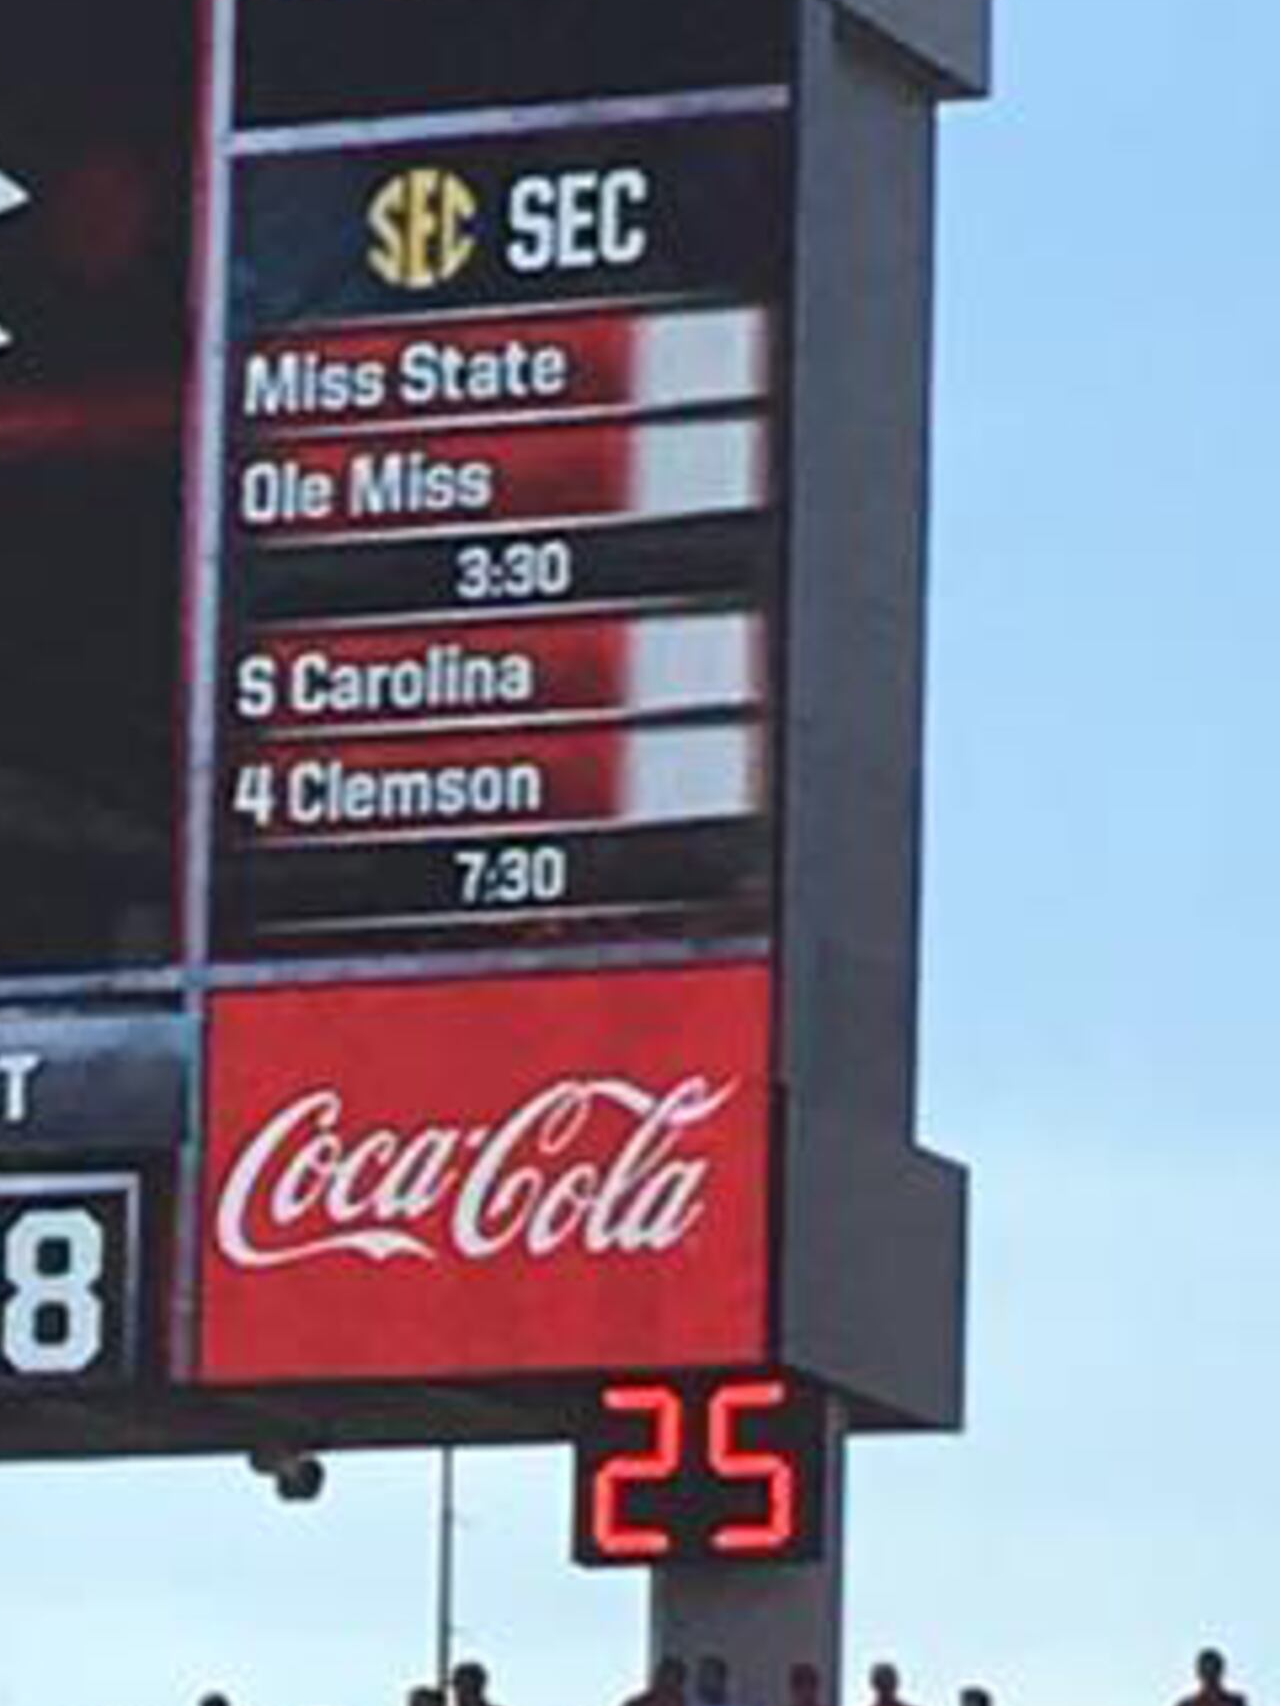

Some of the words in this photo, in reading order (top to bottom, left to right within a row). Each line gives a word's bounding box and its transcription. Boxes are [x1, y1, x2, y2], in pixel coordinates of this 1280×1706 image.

[505, 167, 647, 272] SEC
[243, 355, 386, 415] Miss
[399, 341, 568, 401] State
[241, 462, 333, 523] Ole
[349, 451, 493, 515] Miss
[456, 541, 571, 599] 3:30
[237, 656, 276, 718] S
[289, 645, 533, 710] Carolina
[233, 766, 273, 826] 4
[287, 761, 541, 822] Clemson
[454, 846, 566, 903] 7:30
[216, 1073, 736, 1267] Coca-Cola
[594, 1381, 792, 1553] 25
